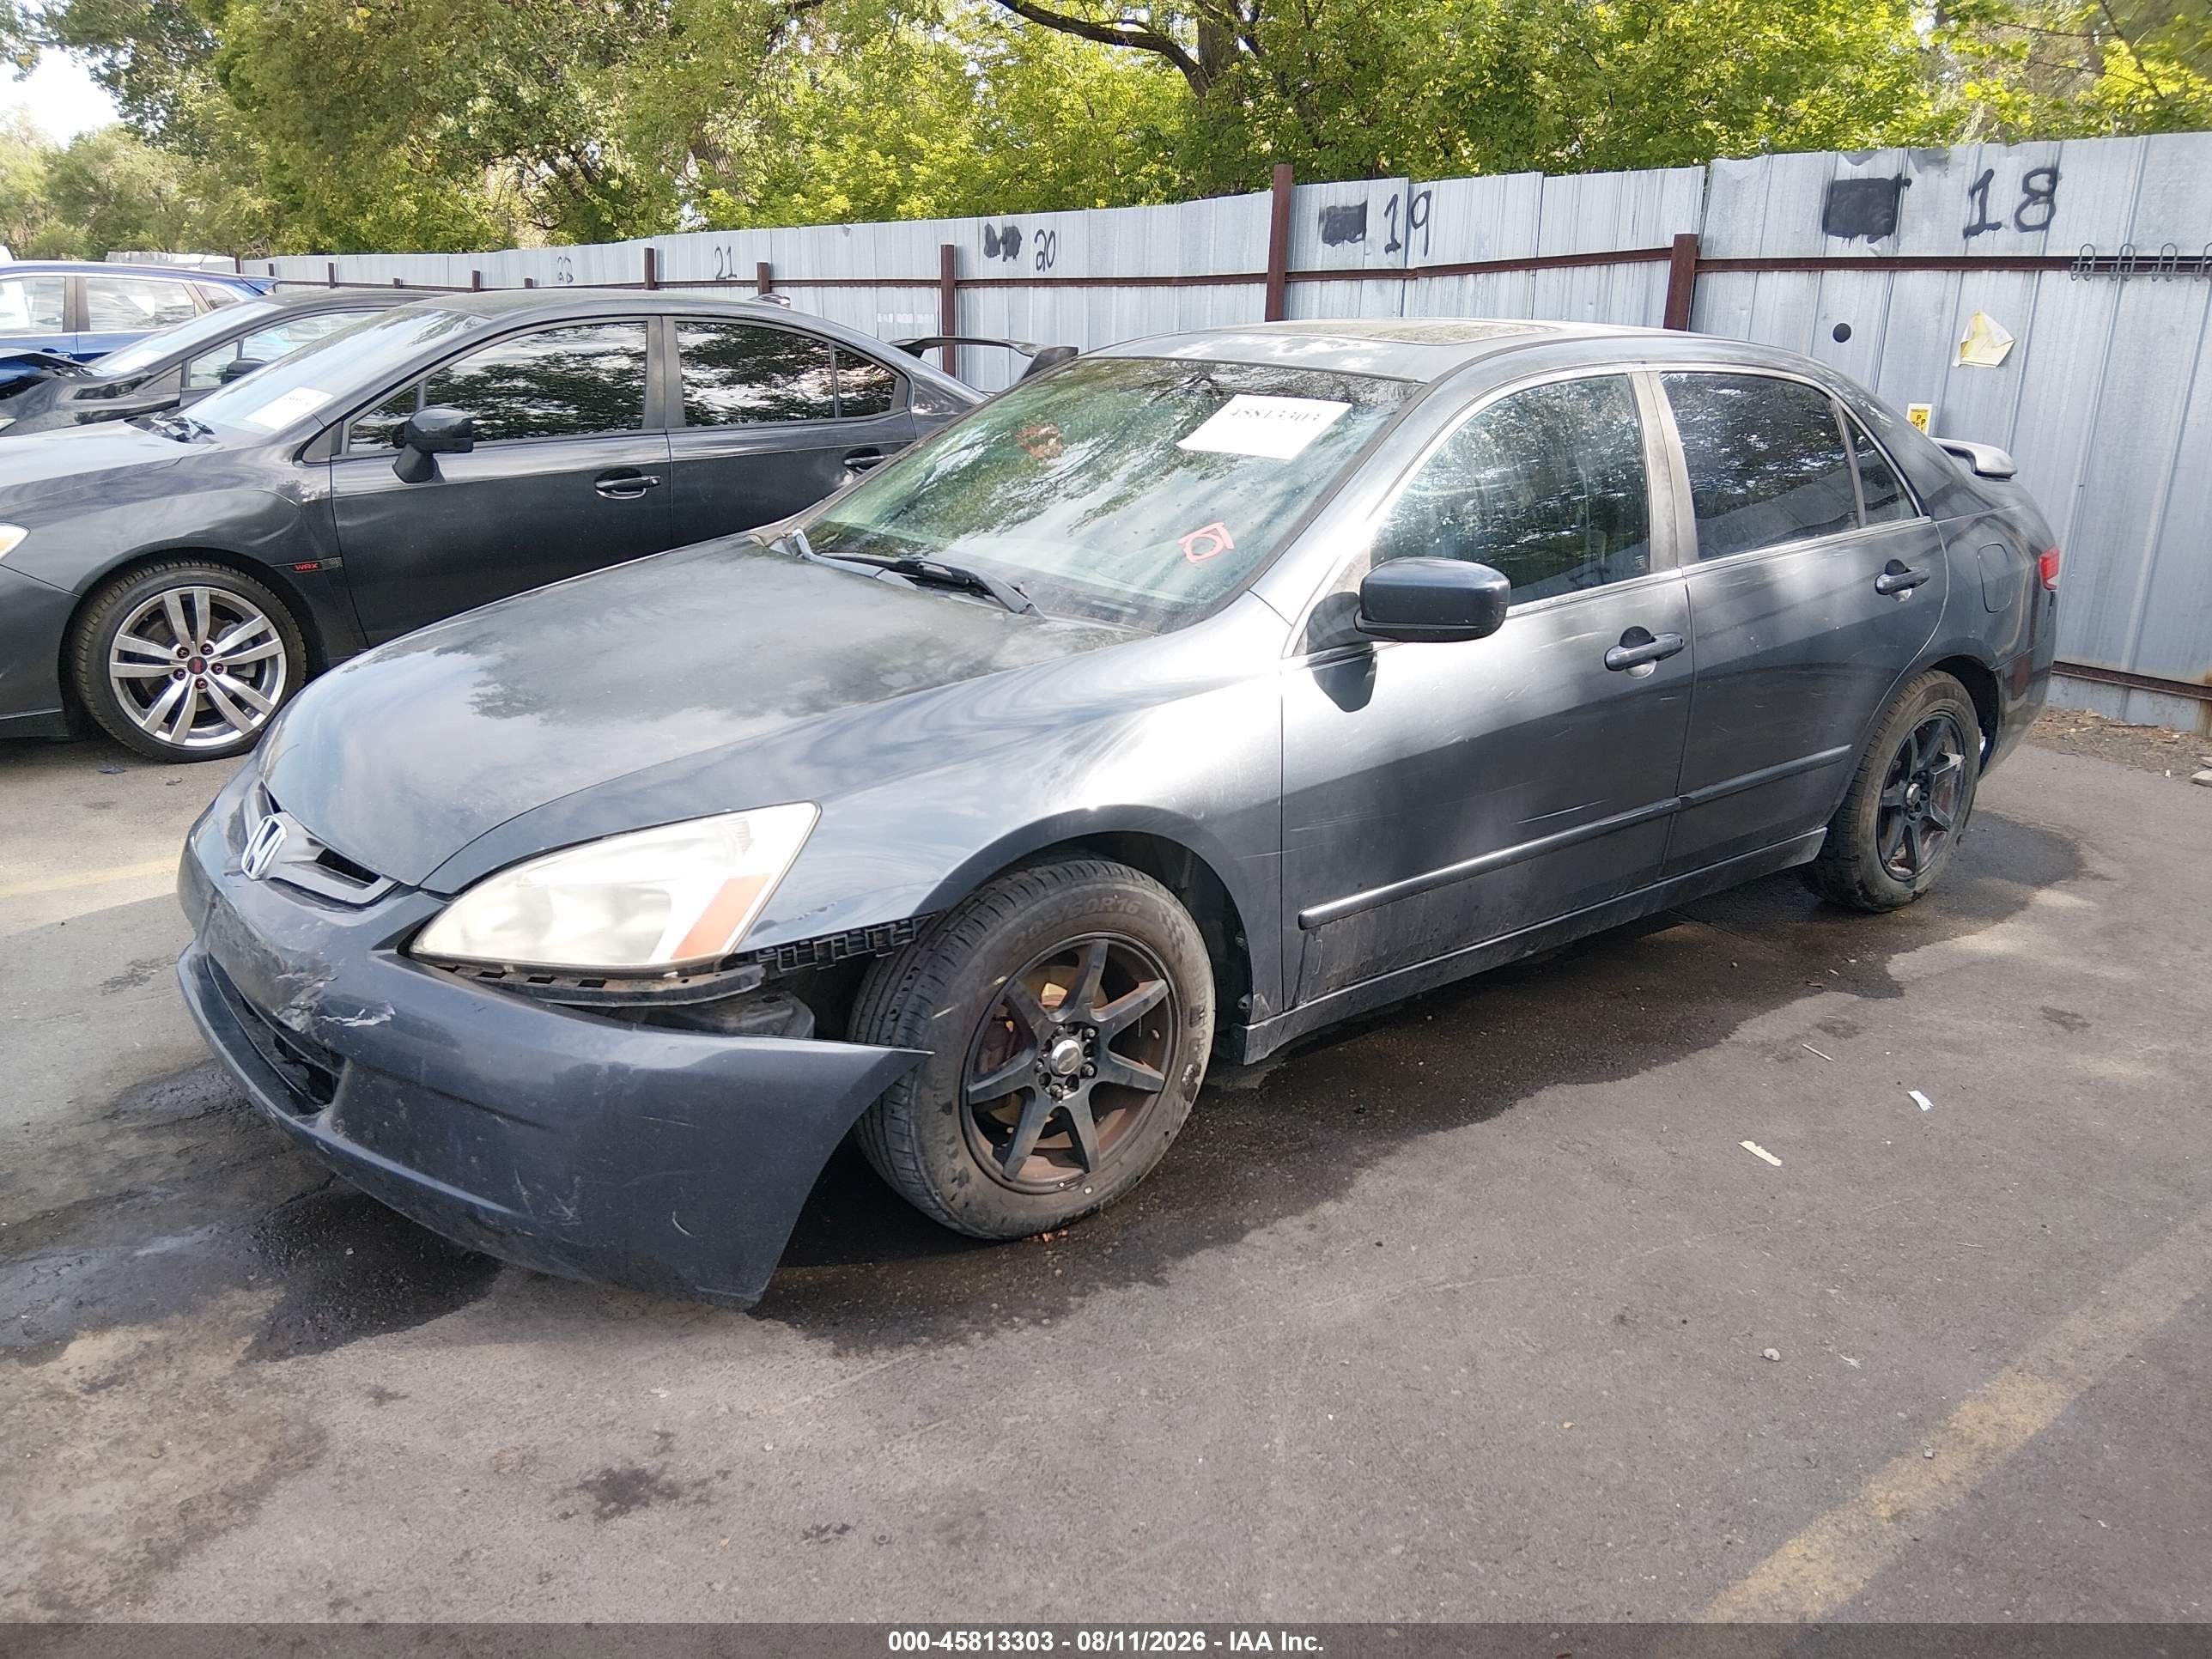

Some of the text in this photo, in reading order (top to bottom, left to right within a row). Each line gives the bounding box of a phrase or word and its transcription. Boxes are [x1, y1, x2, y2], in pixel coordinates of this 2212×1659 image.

[1384, 190, 1432, 258] 19
[1963, 168, 2057, 240] 18
[714, 245, 738, 281] 21
[1034, 228, 1056, 272] 20
